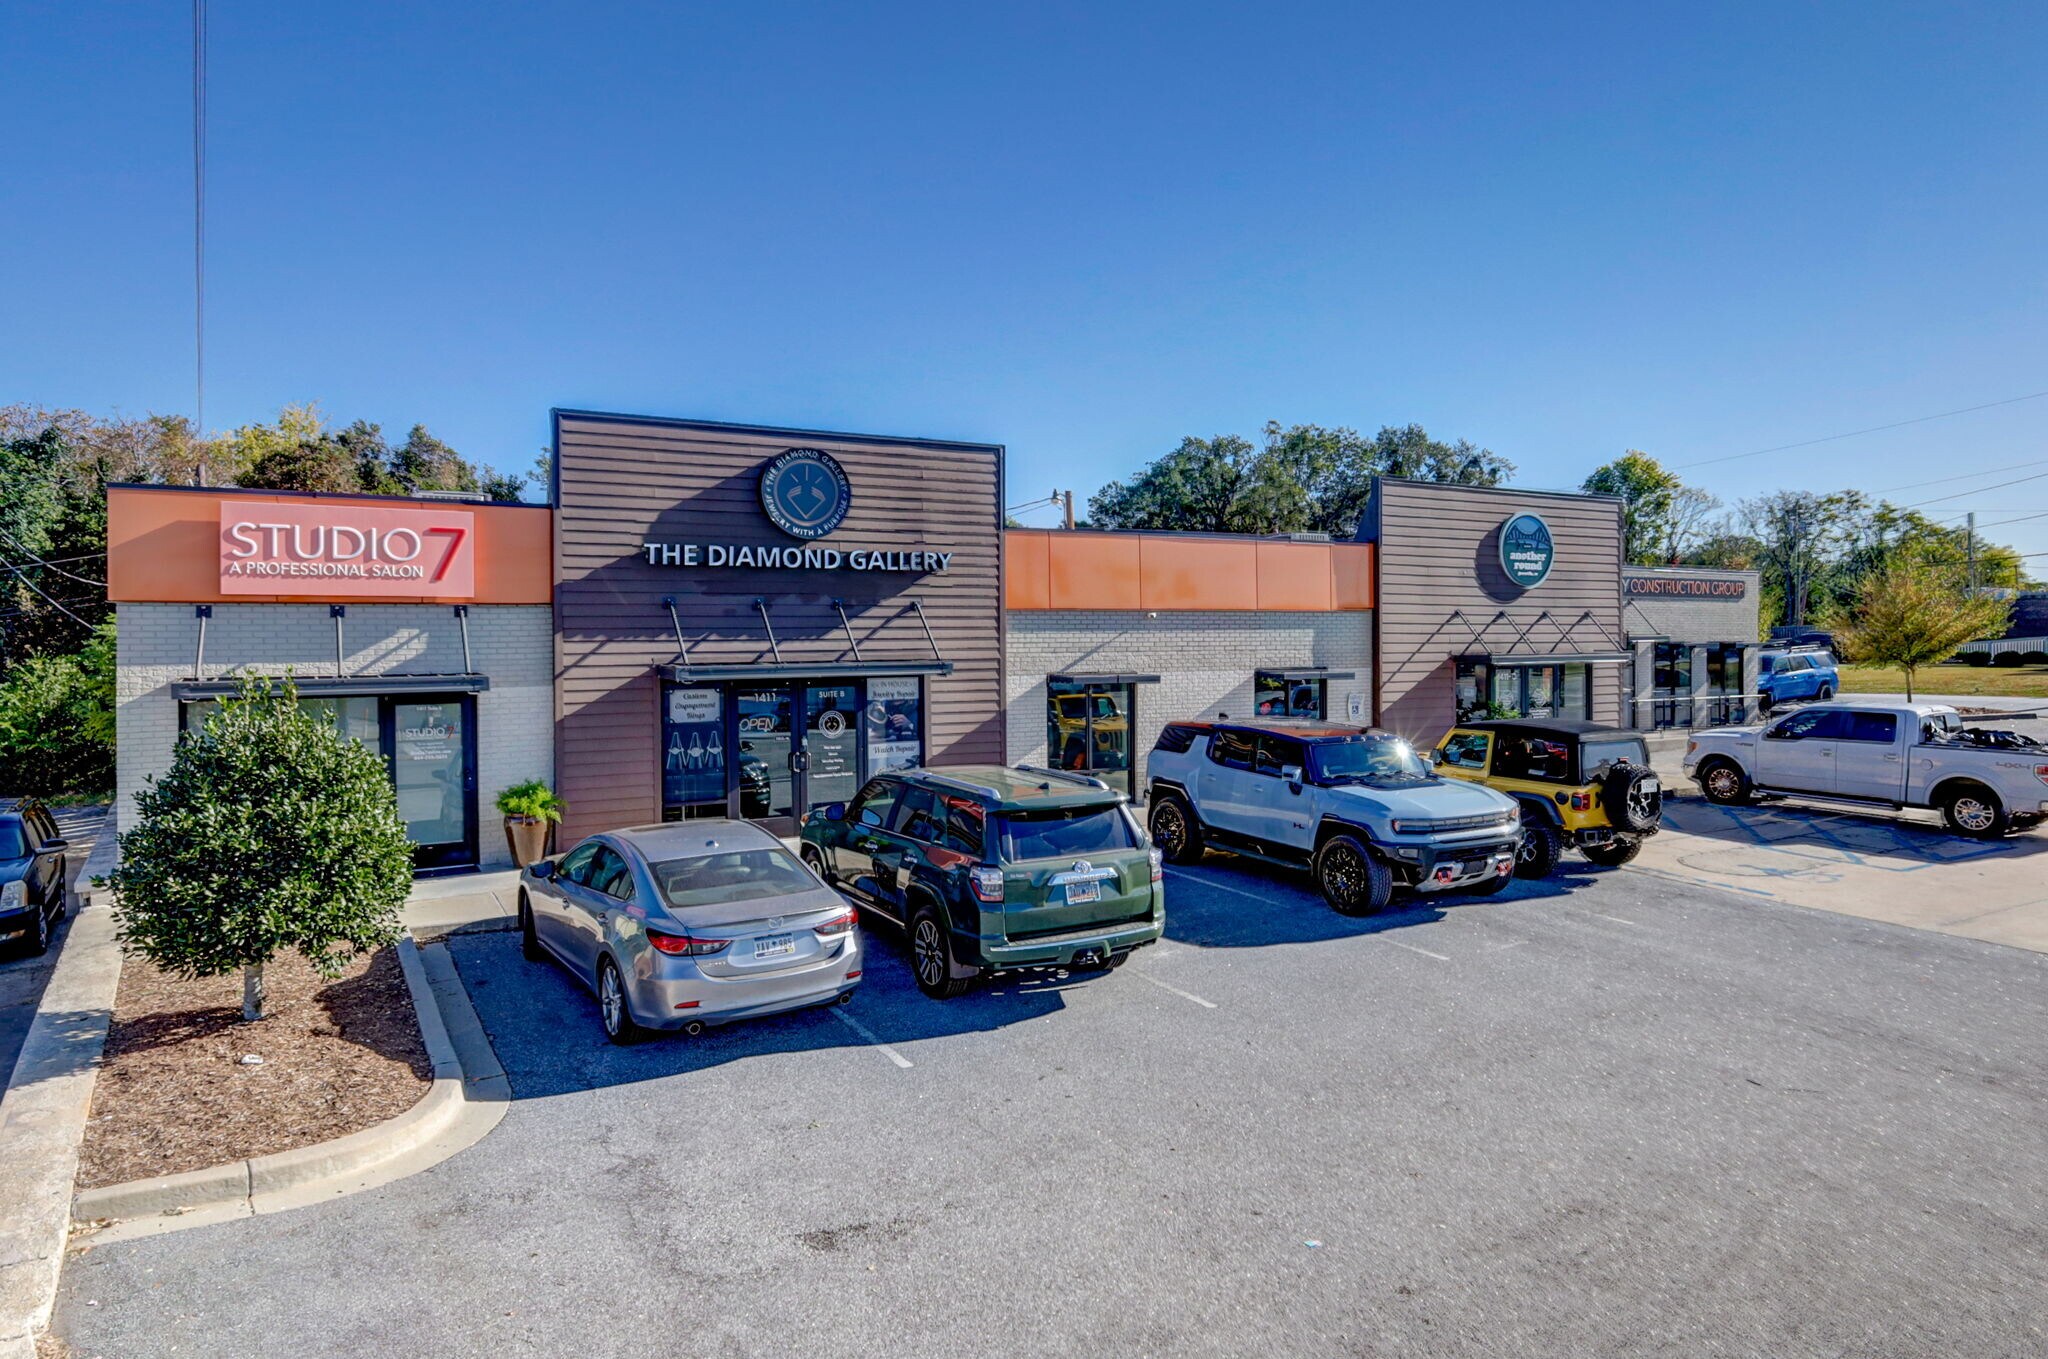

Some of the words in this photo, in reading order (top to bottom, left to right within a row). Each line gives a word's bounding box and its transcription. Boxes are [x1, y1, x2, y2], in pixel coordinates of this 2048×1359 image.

[765, 466, 778, 485] THE
[776, 450, 819, 468] DIAMOND
[821, 456, 848, 491] GALLERY
[764, 493, 791, 529] JEWELRY
[792, 526, 815, 536] WITH
[817, 526, 824, 535] A
[823, 499, 848, 531] PURPOSE
[231, 522, 422, 562] STUDIO
[427, 527, 467, 581] 7
[643, 543, 698, 567] THE
[708, 545, 841, 571] DIAMOND
[850, 550, 953, 572] GALLERY
[1510, 551, 1547, 561] another
[229, 561, 242, 575] A
[246, 561, 368, 577] PROFESSIONAL
[372, 565, 424, 578] SALON
[1513, 561, 1542, 570] round
[1630, 579, 1710, 595] CONSTRUCTION
[1711, 581, 1745, 595] GROUP
[754, 692, 776, 702] 1411
[739, 717, 775, 731] OPEN
[405, 727, 445, 738] STUDIO
[447, 726, 455, 739] 7
